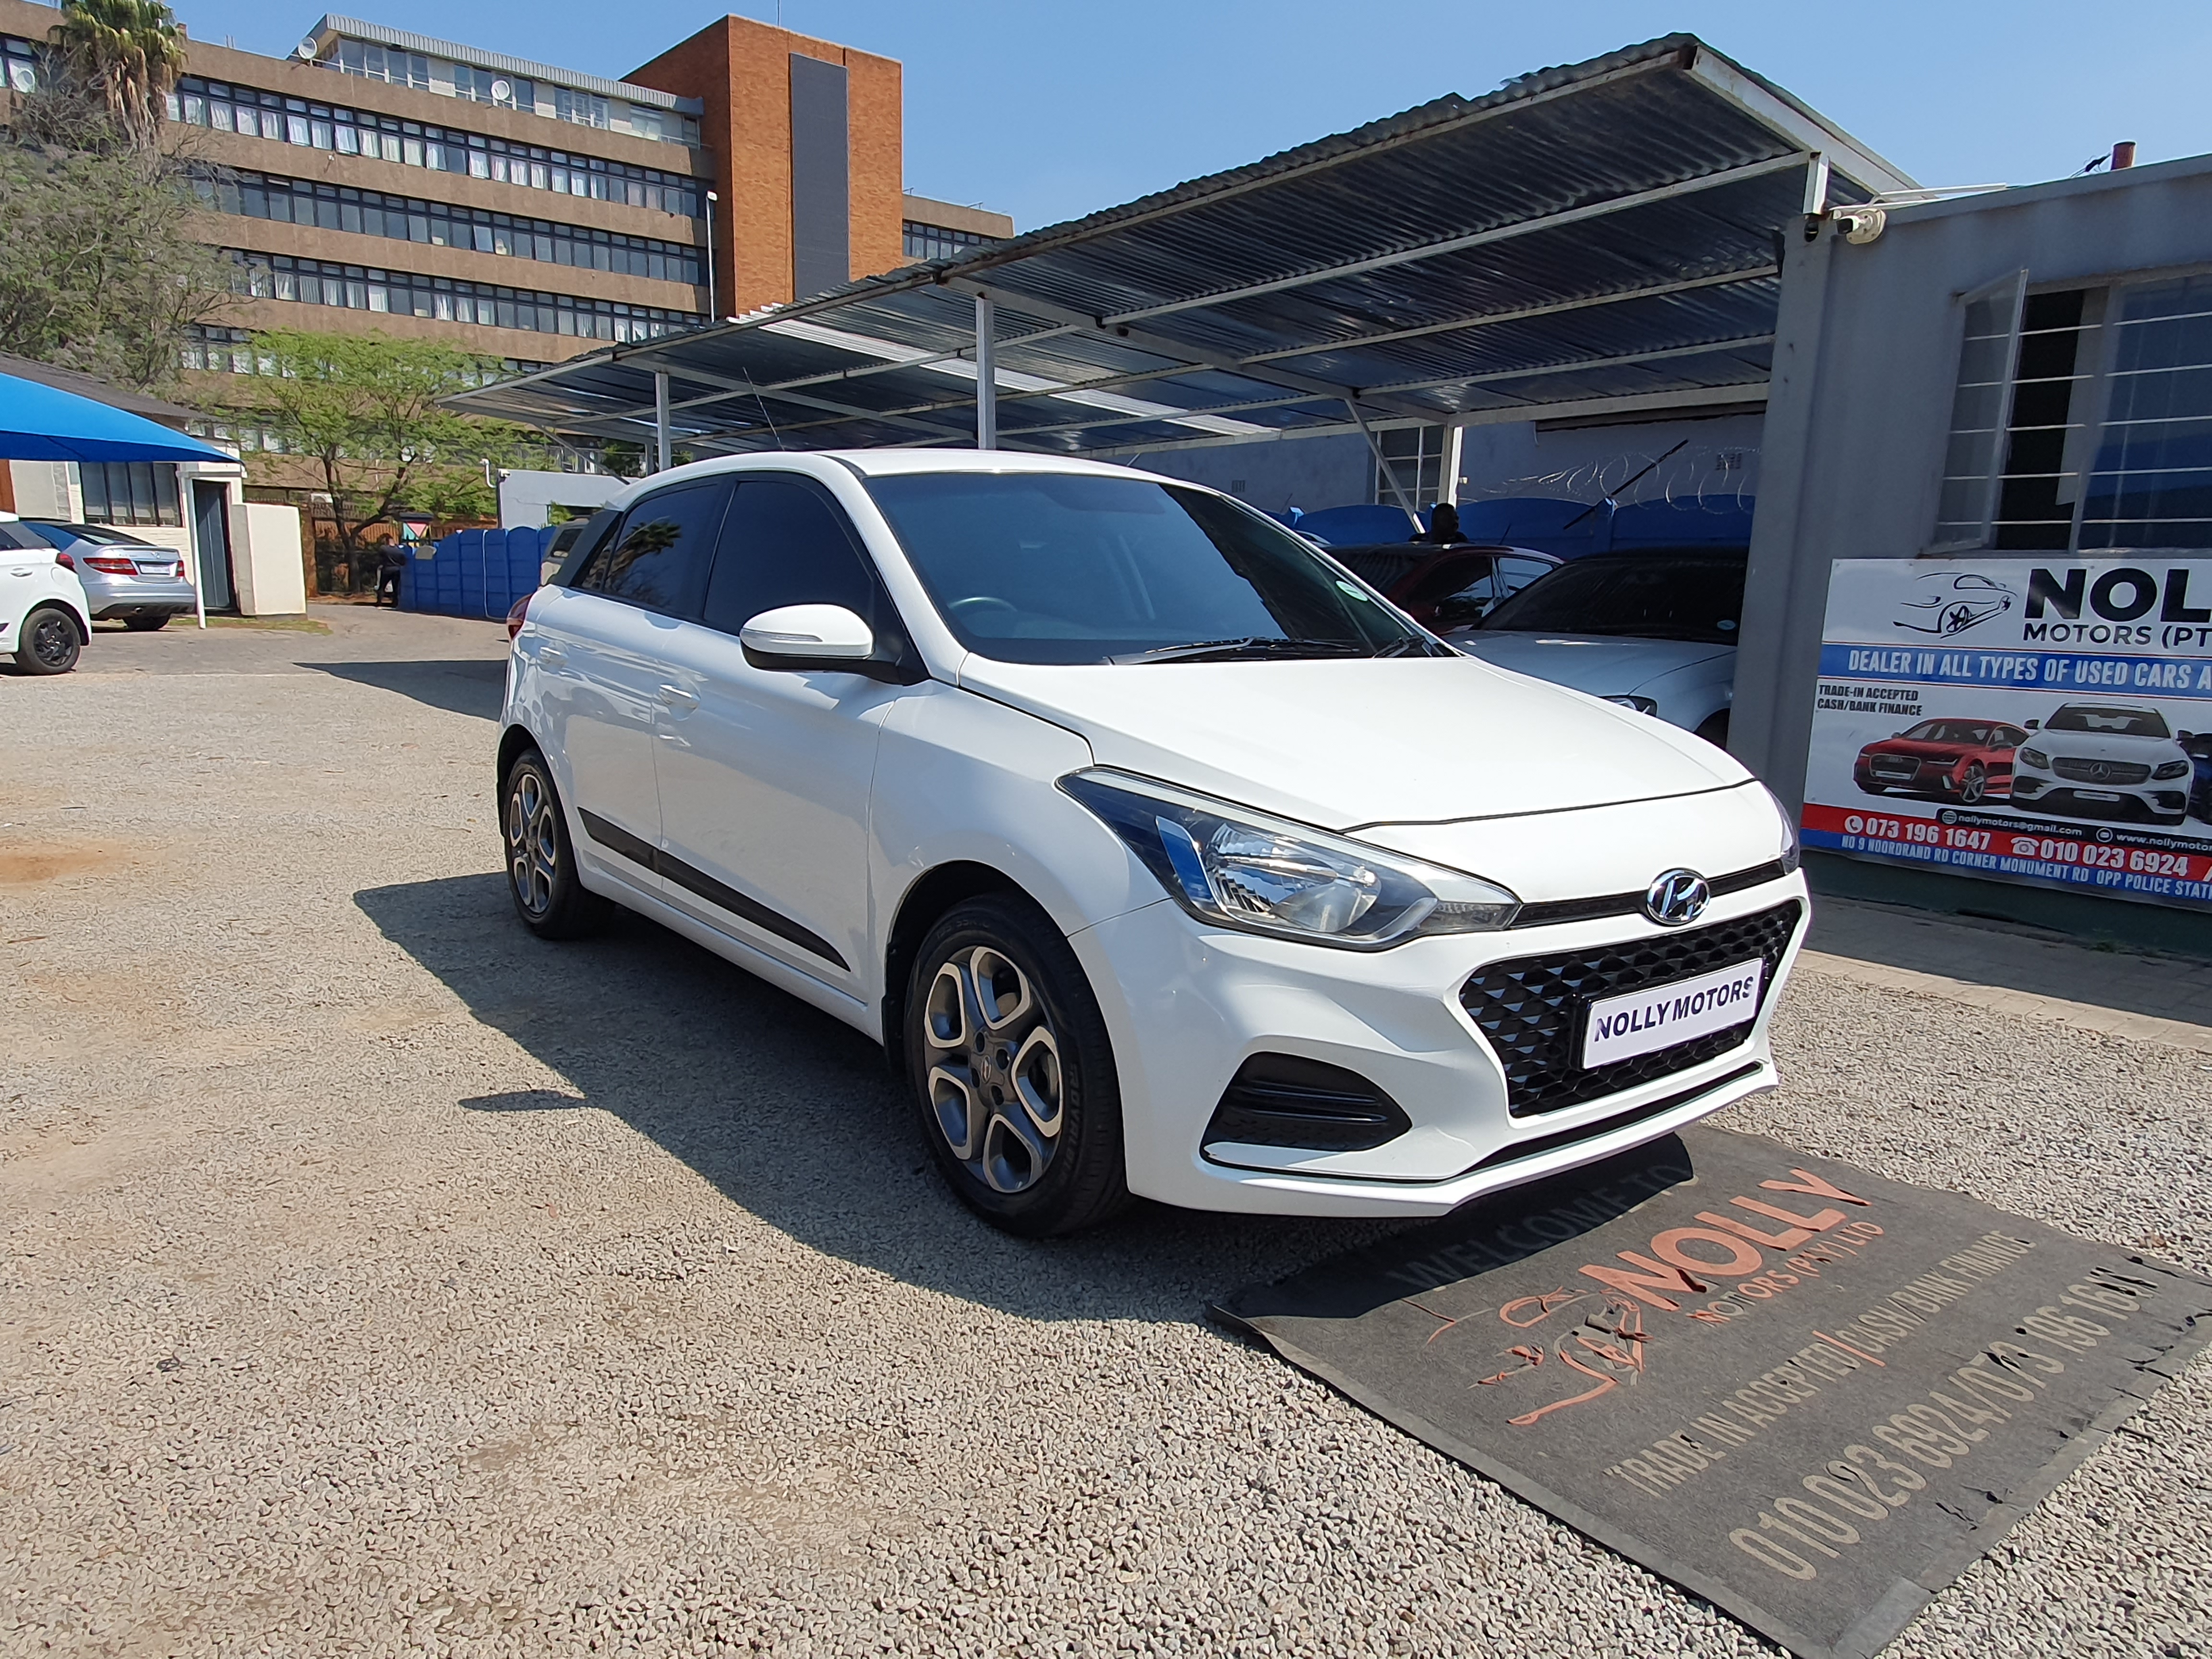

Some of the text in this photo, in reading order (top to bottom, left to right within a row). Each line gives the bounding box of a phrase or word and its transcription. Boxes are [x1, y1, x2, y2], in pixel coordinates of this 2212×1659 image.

[2024, 567, 2212, 623] NOL
[2023, 623, 2212, 649] MOTORS (PT
[1819, 684, 1919, 701] TRADE-IN ACCEPTED
[1848, 649, 1911, 674] DEALER
[1916, 653, 1935, 674] IN
[1938, 654, 1972, 677] ALL
[1979, 656, 2038, 681] TYPES
[2044, 659, 2070, 682] OF
[2074, 660, 2128, 685] USED
[2134, 662, 2192, 688] CARS
[1817, 697, 1923, 717] CASH/BANK FINANCE
[1865, 817, 1991, 851] 073 196 1647
[1958, 815, 2082, 836] nollymotors@gmail.com
[1841, 834, 1856, 849] NO
[1867, 838, 1931, 860] NOORDRAND
[1933, 847, 1949, 863] RD
[1951, 850, 1997, 870] CORNER
[1999, 856, 2069, 880] MONUMENT
[2071, 866, 2090, 882] RD
[2096, 869, 2122, 886] OPP
[2125, 873, 2173, 894] POLICE
[2040, 839, 2079, 862] 010
[2082, 844, 2125, 868] 023
[2129, 850, 2188, 877] 6924
[1594, 975, 1754, 1043] NOLLY MOTORS
[1385, 1165, 1700, 1293] WELCOME TO
[1577, 1167, 1873, 1312] NOLLY
[1685, 1270, 1800, 1329] MOTORS
[1832, 1221, 1885, 1247] LTD
[1602, 1430, 1727, 1499] TRADE
[1689, 1411, 1756, 1447] IN
[1937, 1230, 2037, 1283] FINANCE
[1729, 1497, 1861, 1581] 010
[1802, 1444, 1927, 1521] 023
[1872, 1341, 2065, 1469] 6924/073
[2014, 1305, 2111, 1355] 196
